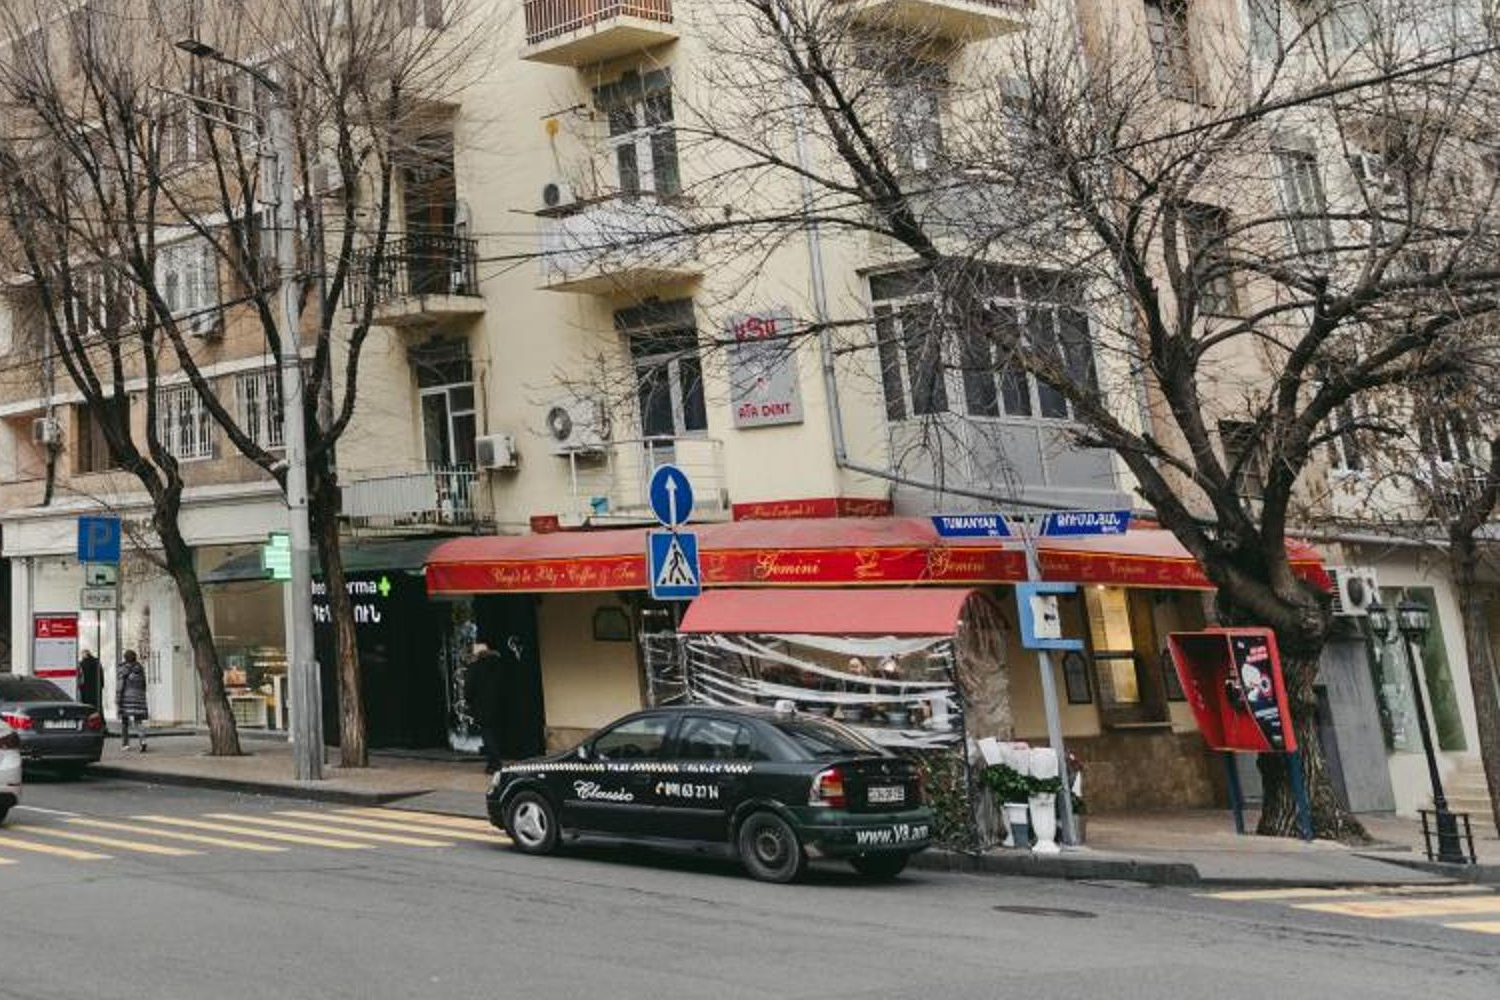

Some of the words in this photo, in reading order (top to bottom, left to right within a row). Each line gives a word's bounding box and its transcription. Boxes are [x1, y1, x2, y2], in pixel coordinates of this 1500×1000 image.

[762, 402, 790, 417] DENT
[942, 516, 997, 530] TUMANYAN
[607, 763, 629, 772] TAXI
[573, 779, 634, 801] Classic
